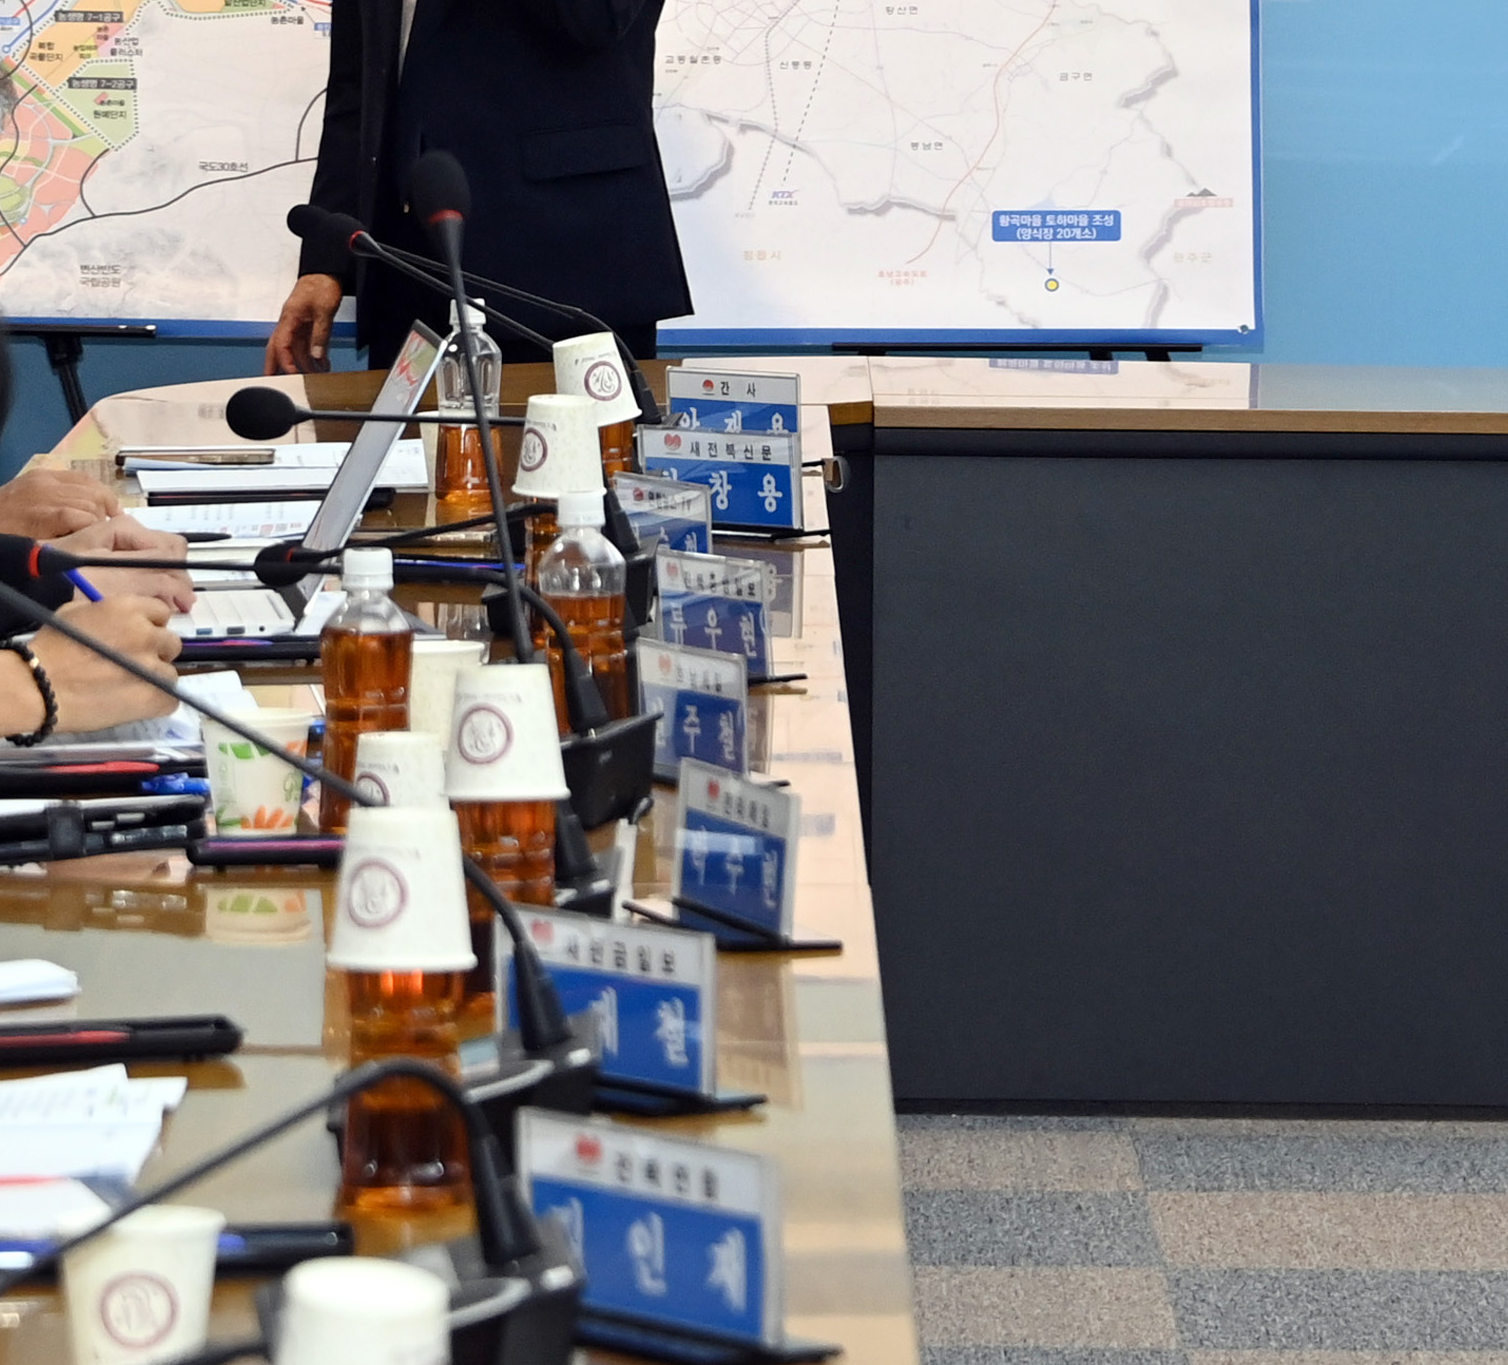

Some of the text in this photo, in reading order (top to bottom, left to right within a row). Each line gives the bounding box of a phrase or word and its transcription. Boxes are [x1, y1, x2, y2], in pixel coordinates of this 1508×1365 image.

[198, 161, 249, 173] 국도30호선
[771, 190, 795, 199] KTX
[1045, 214, 1090, 226] 토하마을
[1092, 214, 1115, 227] 조성
[1016, 227, 1097, 240] (양식장 20개소)
[690, 441, 773, 461] 새전북신문
